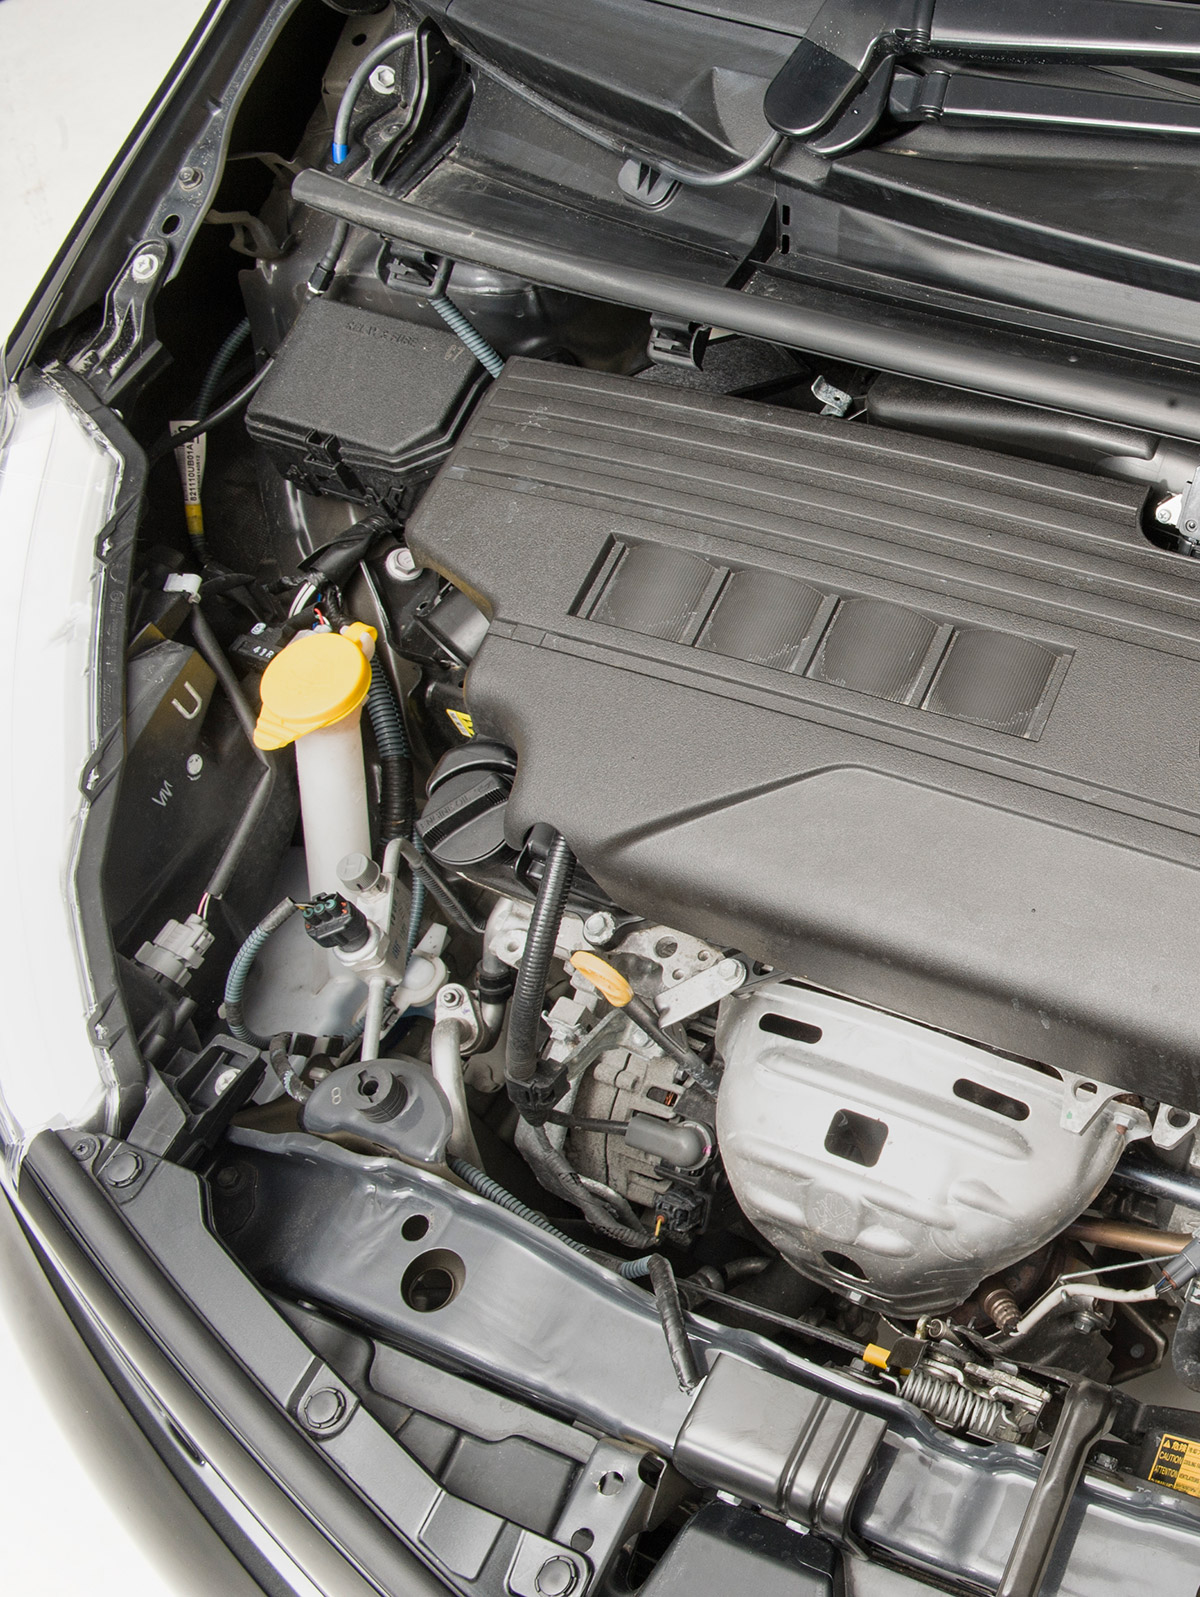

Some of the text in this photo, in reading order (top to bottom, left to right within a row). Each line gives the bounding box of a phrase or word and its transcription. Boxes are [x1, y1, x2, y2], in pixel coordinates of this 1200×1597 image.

[172, 681, 202, 720] U
[330, 1086, 342, 1105] 8
[1158, 1450, 1184, 1464] CAUTION
[1155, 1464, 1179, 1478] ATTENTION
